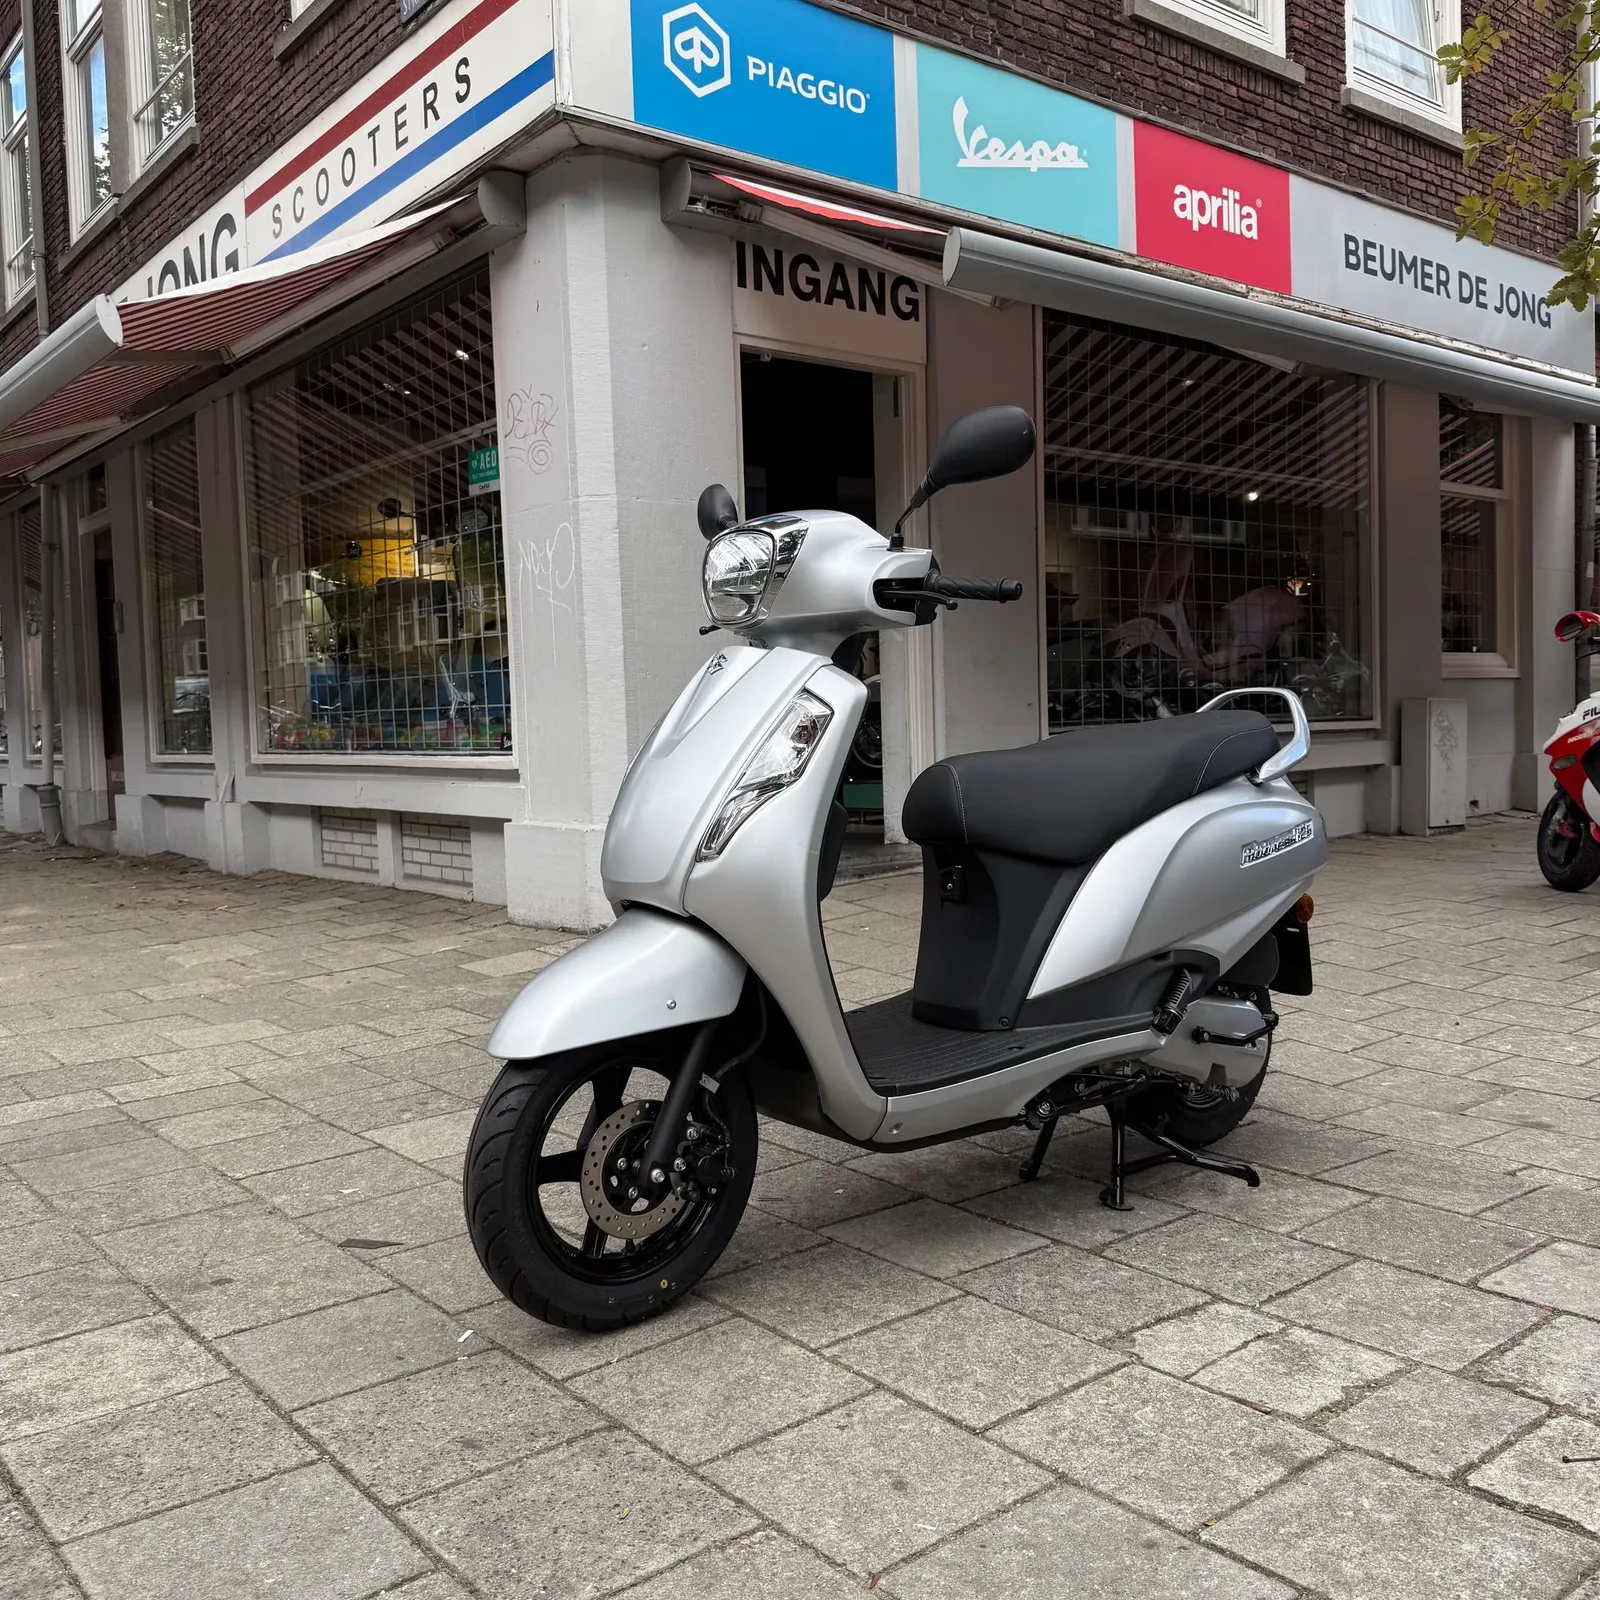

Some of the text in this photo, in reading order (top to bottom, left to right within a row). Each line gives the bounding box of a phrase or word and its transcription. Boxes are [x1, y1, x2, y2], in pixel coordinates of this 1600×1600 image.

[747, 55, 866, 114] PIAGGIO
[272, 57, 471, 239] SCOOTERS
[953, 96, 1089, 172] Vespa
[1173, 184, 1258, 240] aprilia
[147, 213, 239, 298] NG
[736, 240, 920, 322] INGANG
[1344, 233, 1551, 329] BEUMER DE JONG
[480, 450, 497, 470] AED
